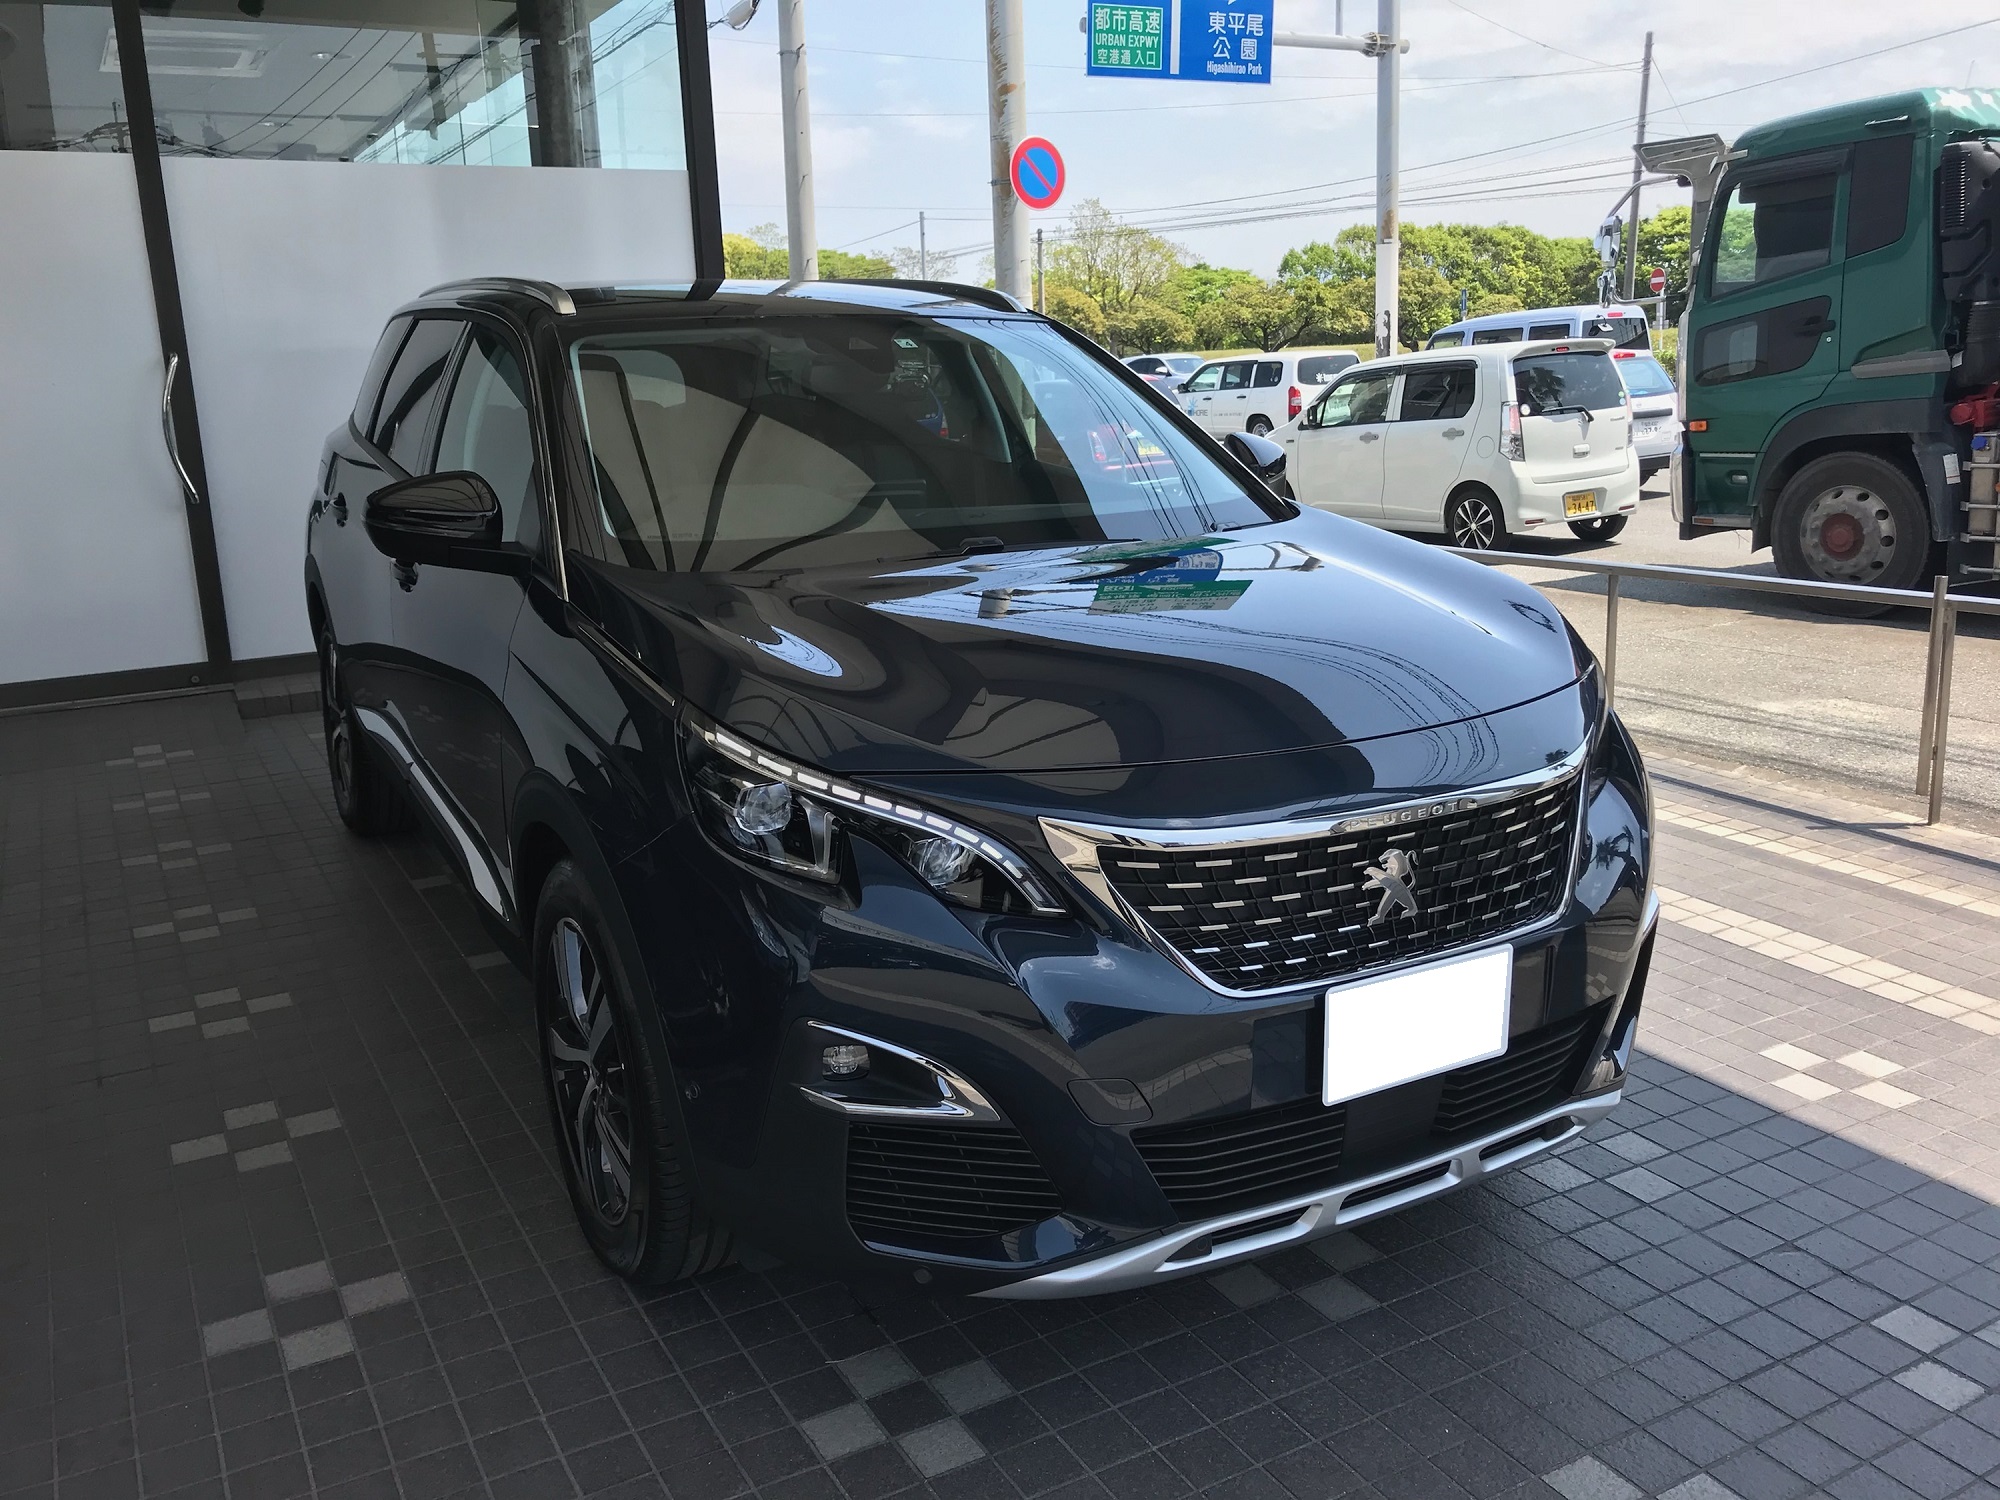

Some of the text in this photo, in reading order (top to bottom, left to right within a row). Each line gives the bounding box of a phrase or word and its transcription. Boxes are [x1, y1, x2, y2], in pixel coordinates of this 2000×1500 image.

[1095, 7, 1160, 34] 都市高速
[1208, 11, 1264, 36] 東平尾
[1095, 33, 1159, 48] URBAN EXPWY
[1213, 36, 1258, 60] 公園
[1206, 60, 1263, 75] Higashihirao Park
[1350, 801, 1458, 828] PEUGEOT
